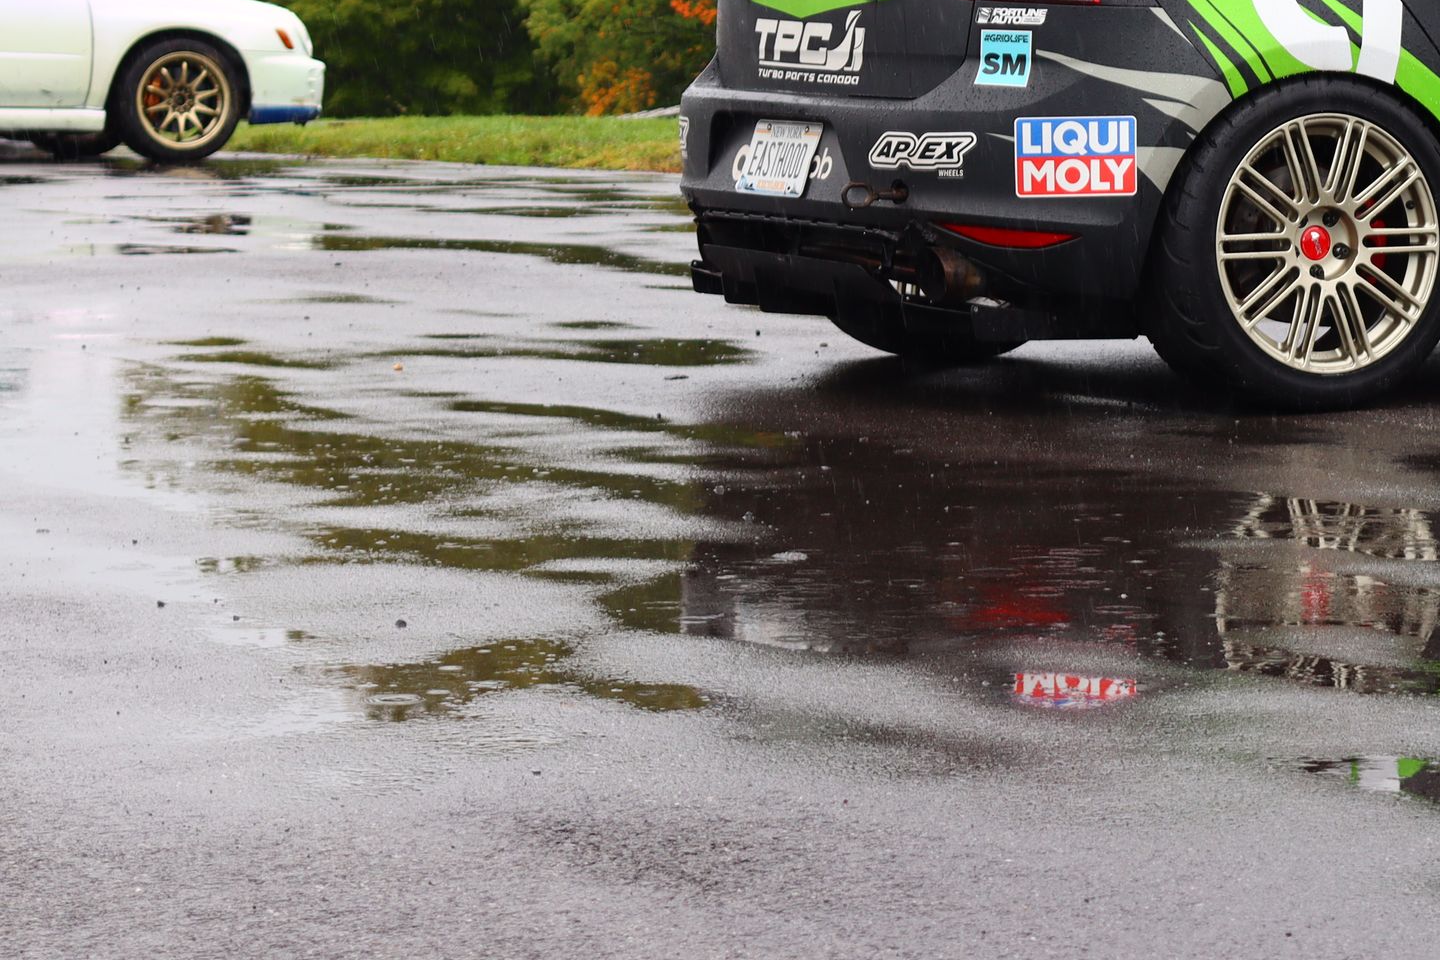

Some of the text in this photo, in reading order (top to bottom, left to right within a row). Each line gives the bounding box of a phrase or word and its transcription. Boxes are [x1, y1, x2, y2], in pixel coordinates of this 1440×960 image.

[991, 16, 1022, 24] AUTO
[992, 7, 1048, 17] FORTUNE
[755, 18, 833, 66] TPC
[984, 34, 1029, 44] #GRIDLIFE
[982, 52, 1027, 76] SM
[771, 126, 788, 137] NEW
[1021, 120, 1130, 156] LIQUI
[747, 140, 809, 179] EASTHOOD
[875, 139, 965, 160] APEX
[938, 169, 964, 177] WHEELS
[1021, 155, 1131, 193] MOLY
